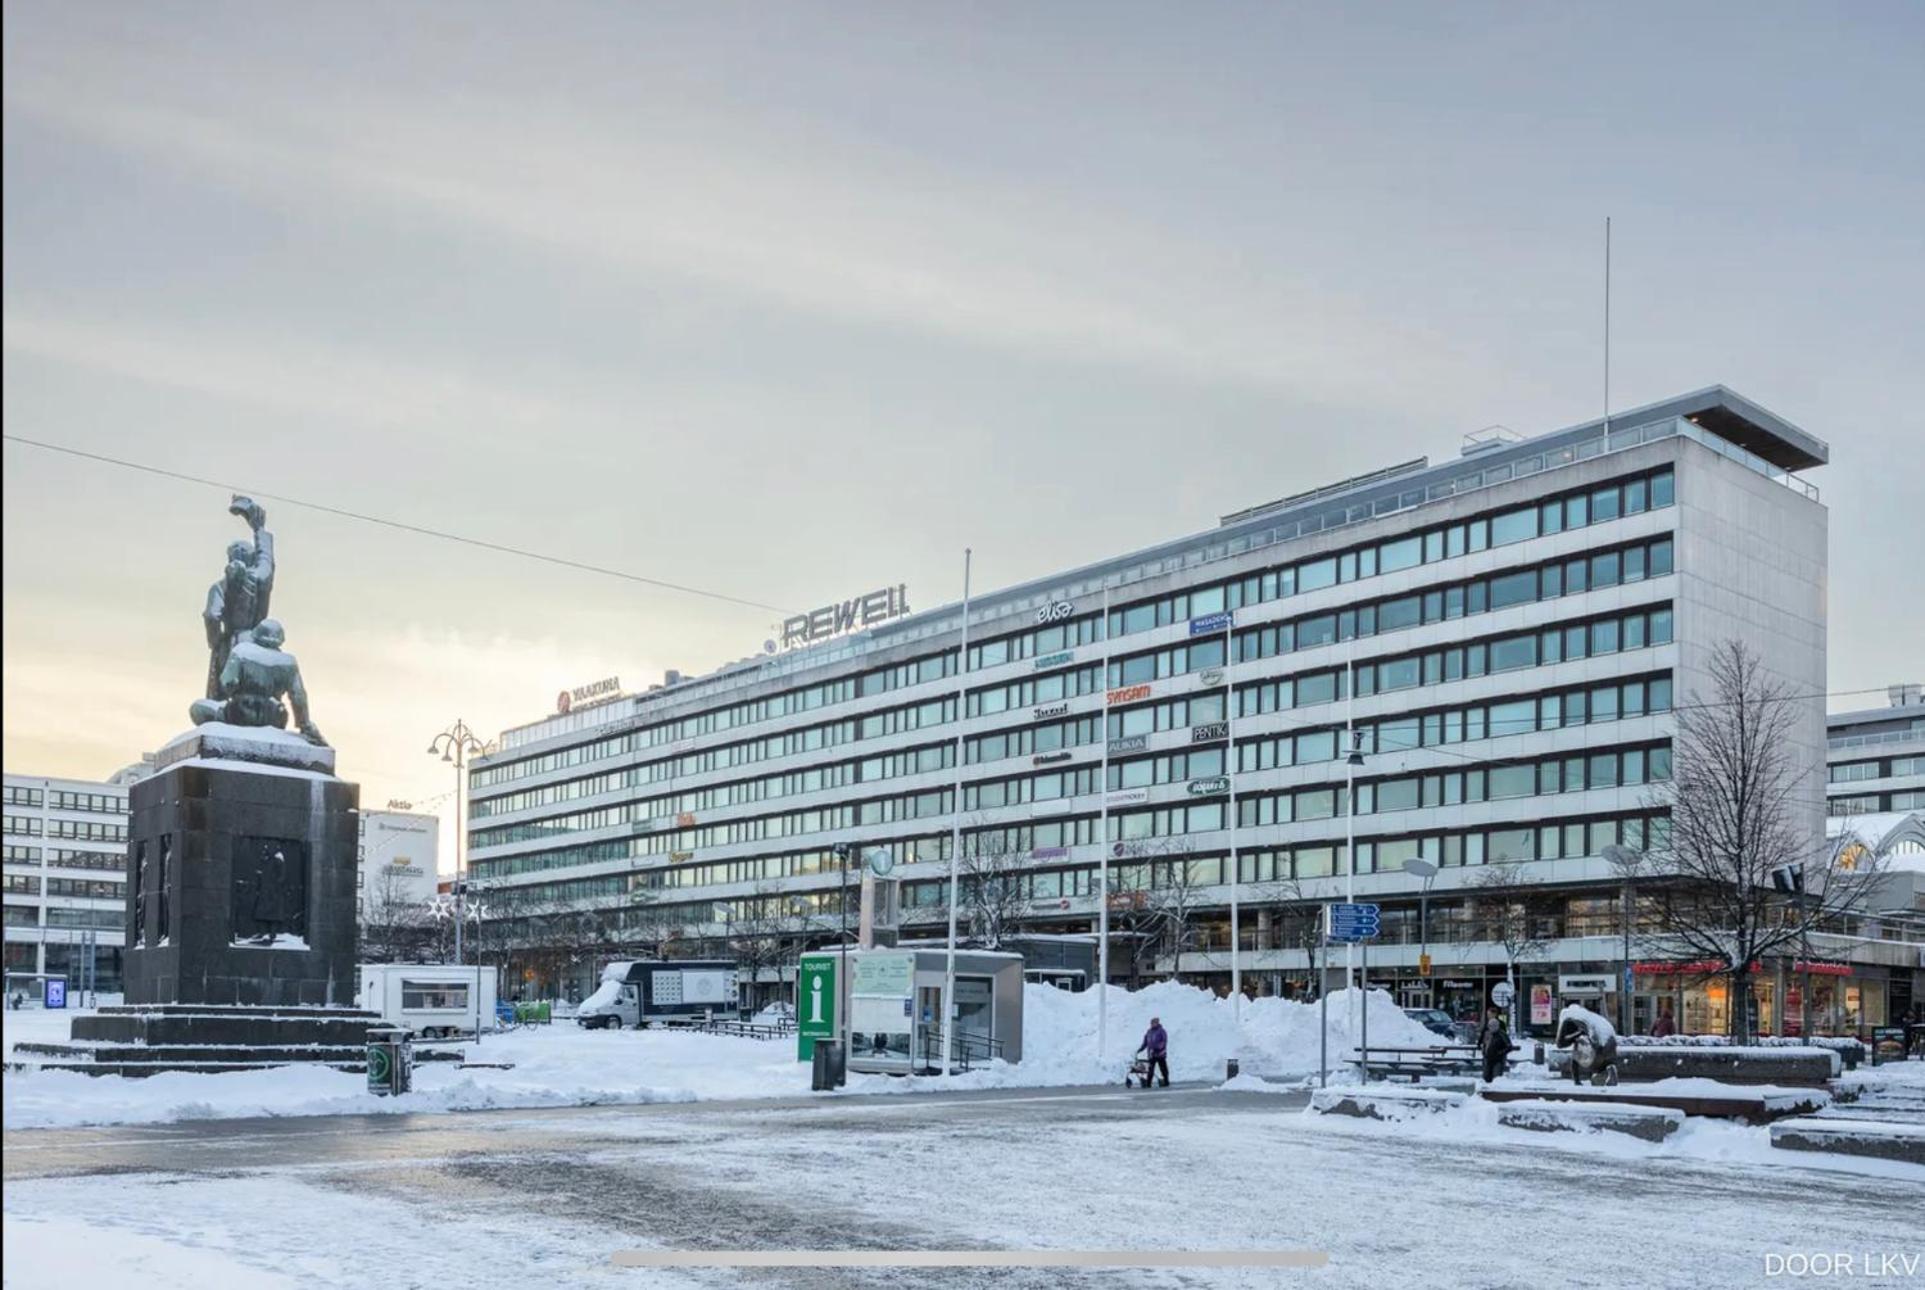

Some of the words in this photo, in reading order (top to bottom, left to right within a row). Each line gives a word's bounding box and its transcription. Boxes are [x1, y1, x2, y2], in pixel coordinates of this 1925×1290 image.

[783, 583, 910, 648] REWELL
[1037, 599, 1074, 624] elisa
[1194, 722, 1227, 739] PENTIK
[804, 962, 831, 971] TOURIST
